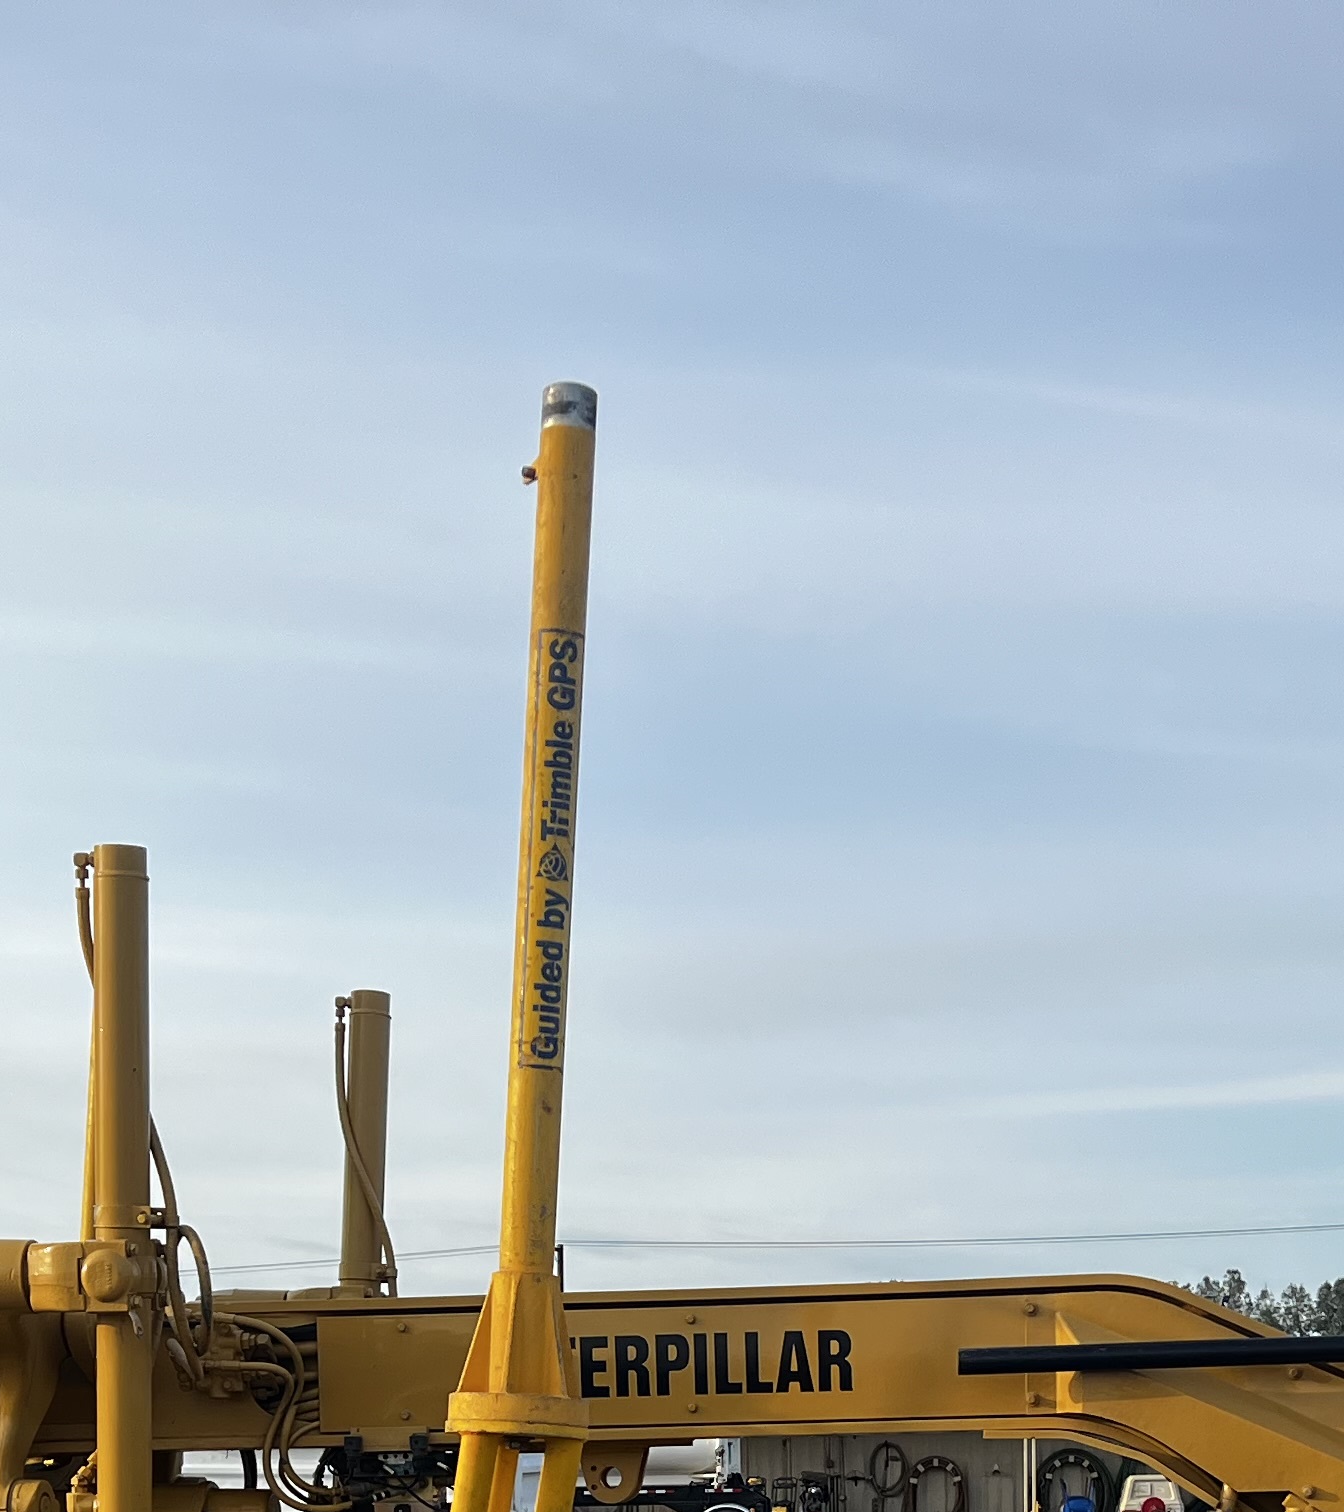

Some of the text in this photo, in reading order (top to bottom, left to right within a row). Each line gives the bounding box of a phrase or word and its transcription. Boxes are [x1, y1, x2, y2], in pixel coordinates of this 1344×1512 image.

[530, 638, 579, 1060] Guided by Trimble GPS
[570, 1330, 854, 1399] ERPILLAR
